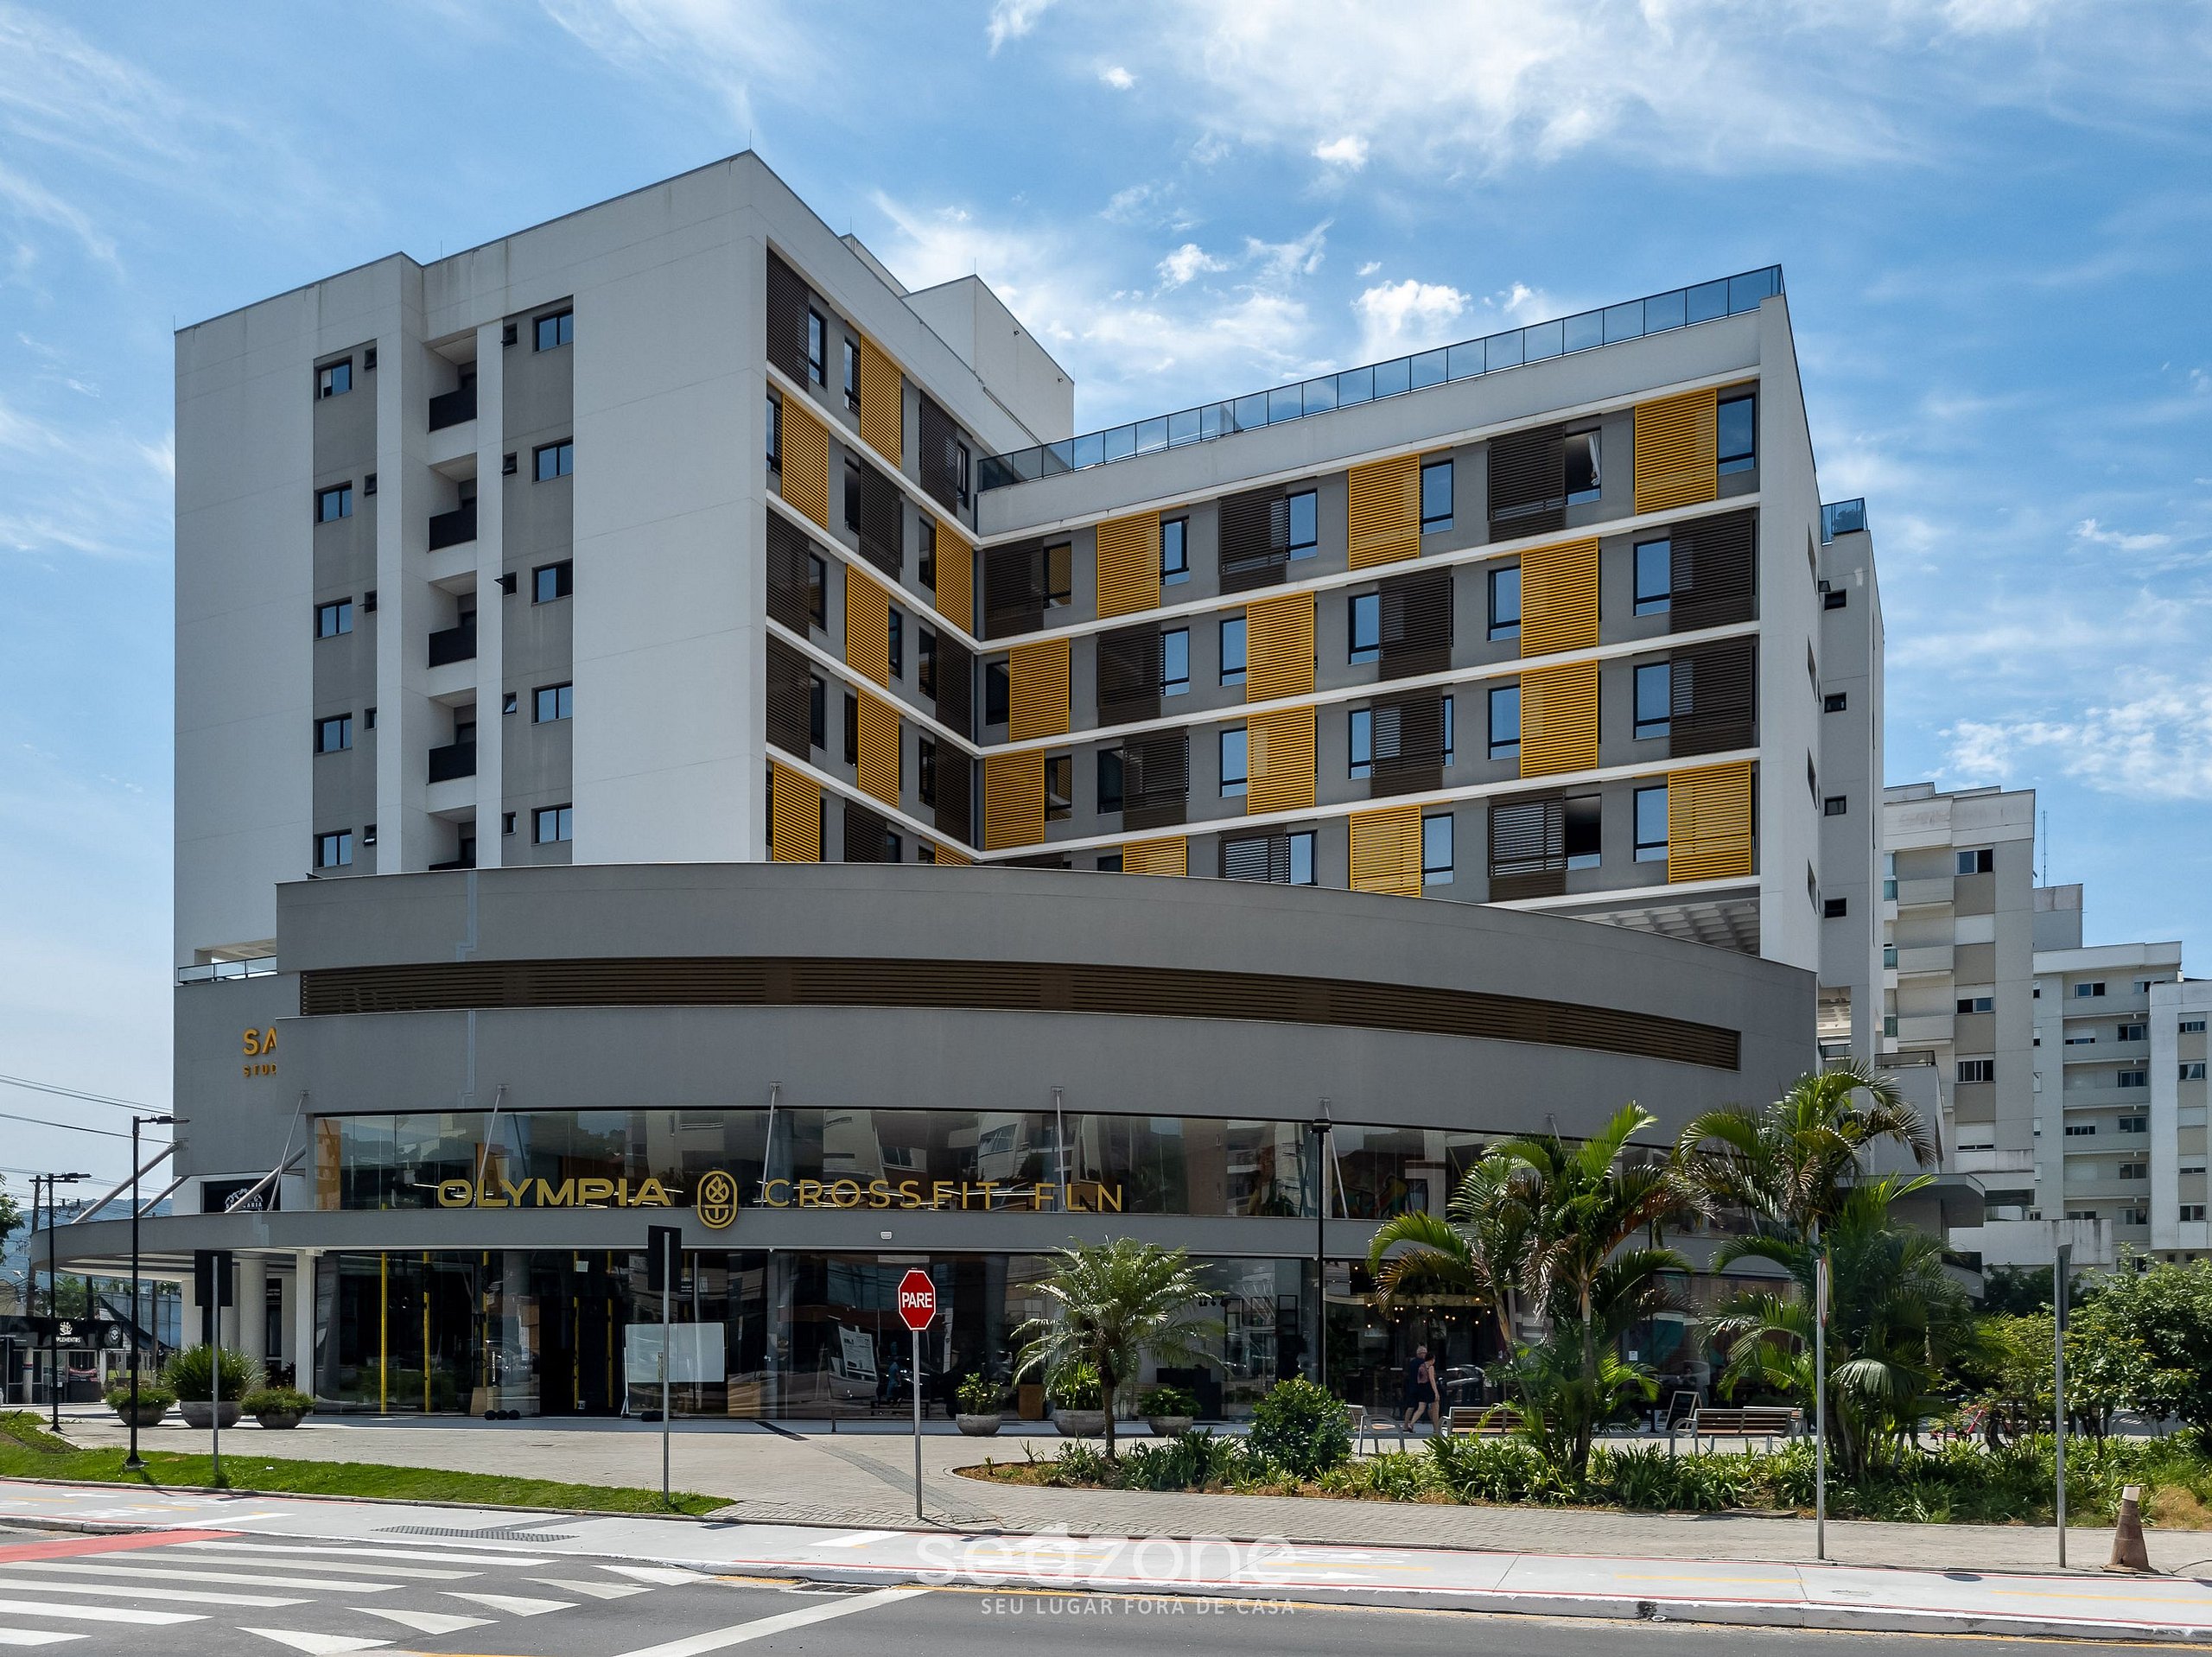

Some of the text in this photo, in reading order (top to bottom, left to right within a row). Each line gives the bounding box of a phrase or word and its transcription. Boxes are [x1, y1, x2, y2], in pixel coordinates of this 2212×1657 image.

[243, 1027, 276, 1056] SA
[437, 1178, 672, 1208] OLYMPIA
[765, 1178, 1122, 1211] CROSSFIT FLN
[901, 1292, 933, 1308] PARE
